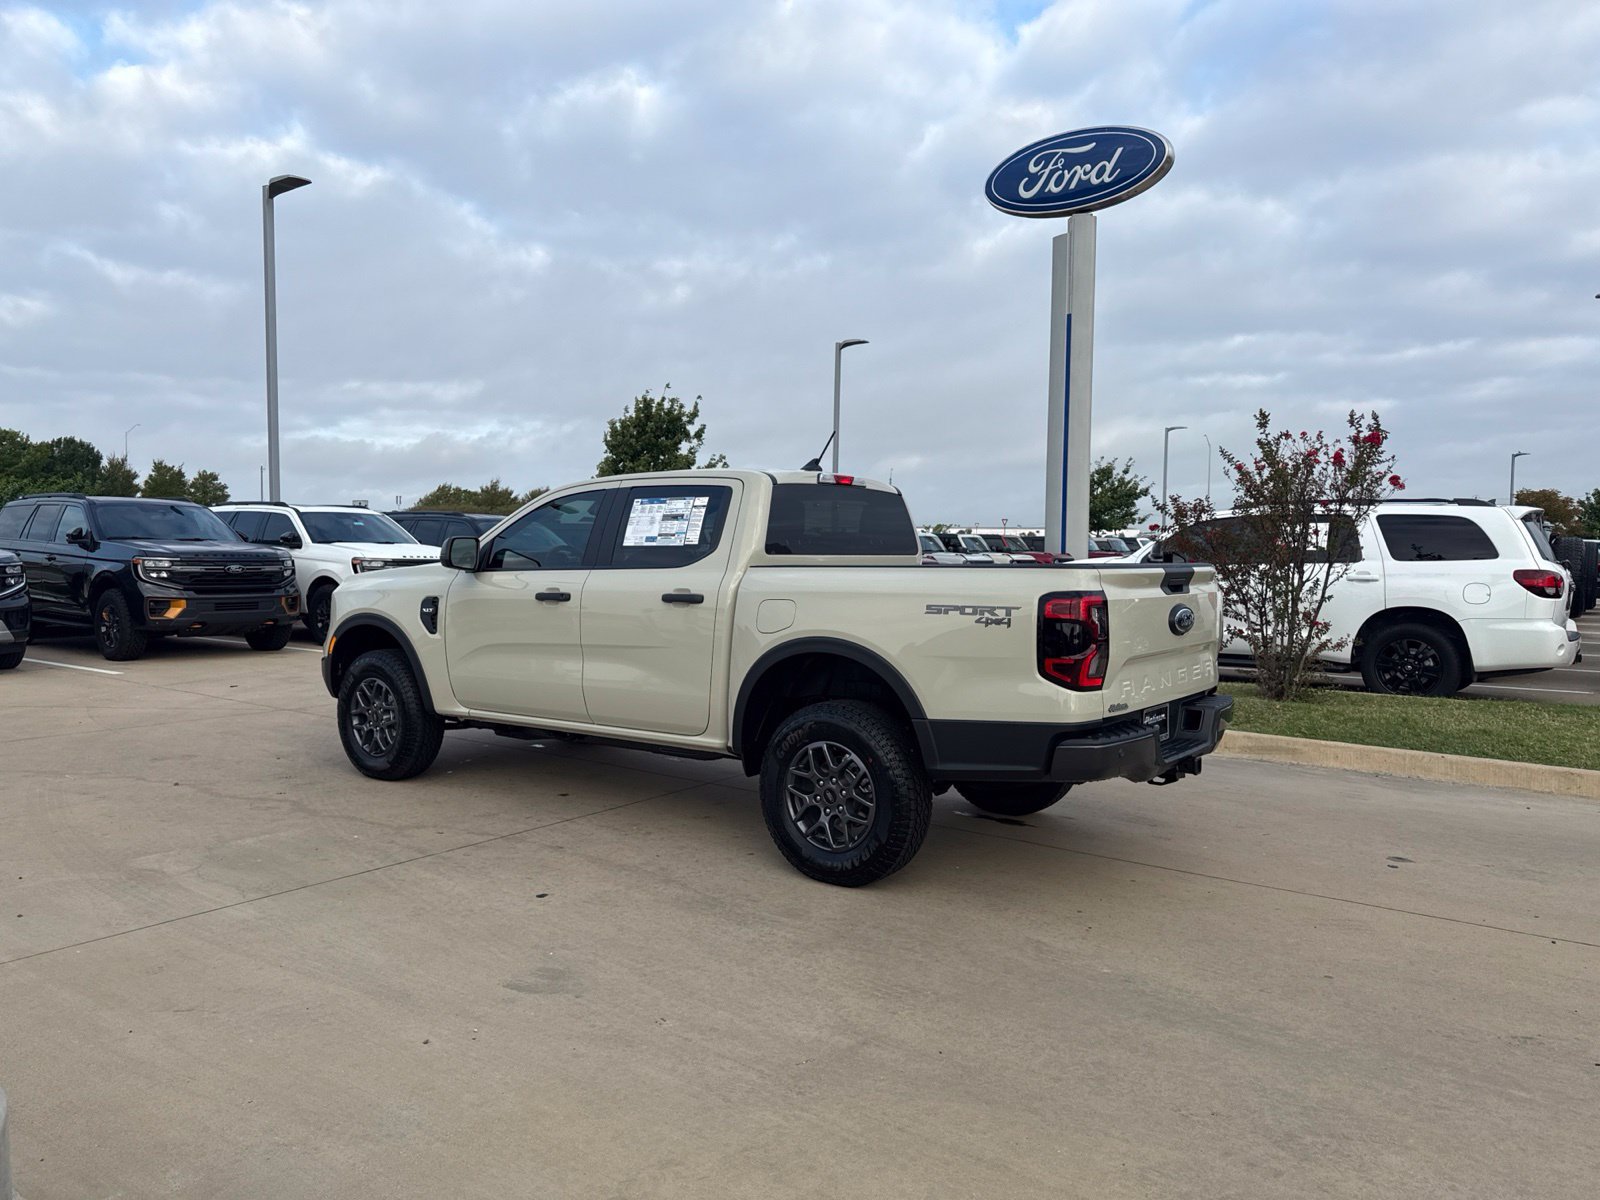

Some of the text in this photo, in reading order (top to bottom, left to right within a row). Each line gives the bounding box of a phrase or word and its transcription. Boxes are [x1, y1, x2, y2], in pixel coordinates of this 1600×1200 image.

[1018, 142, 1124, 199] Ford
[924, 604, 1022, 617] SPORT
[1120, 658, 1215, 698] RANGER
